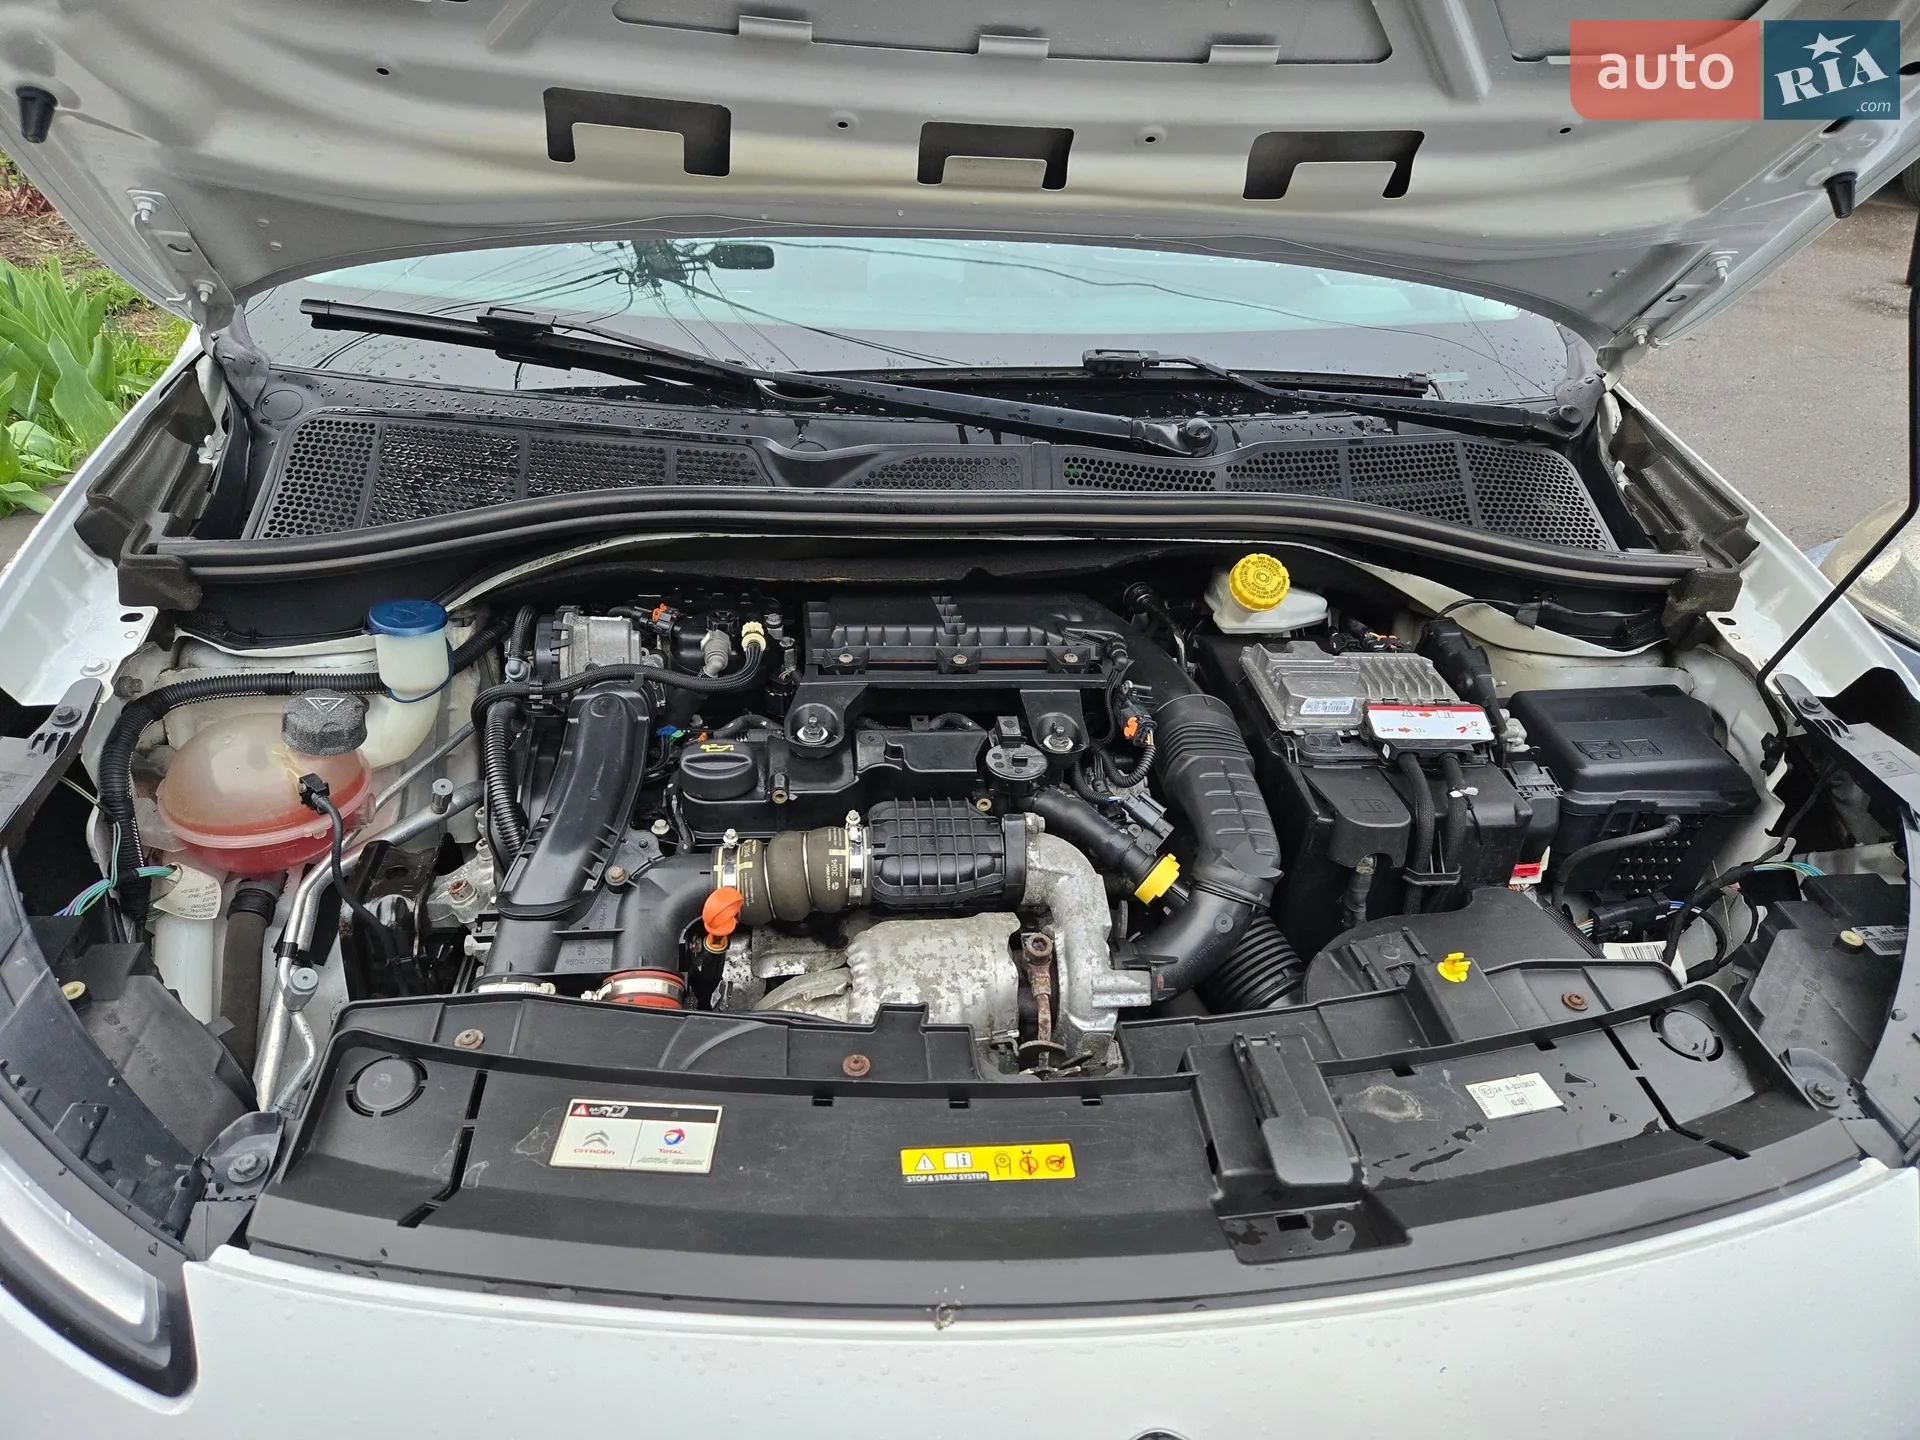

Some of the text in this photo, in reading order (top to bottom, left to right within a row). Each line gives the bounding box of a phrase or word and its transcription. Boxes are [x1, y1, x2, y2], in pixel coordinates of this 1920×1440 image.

[658, 1147, 683, 1155] TOTAL
[906, 1172, 988, 1183] STOP & START SYSTEM
